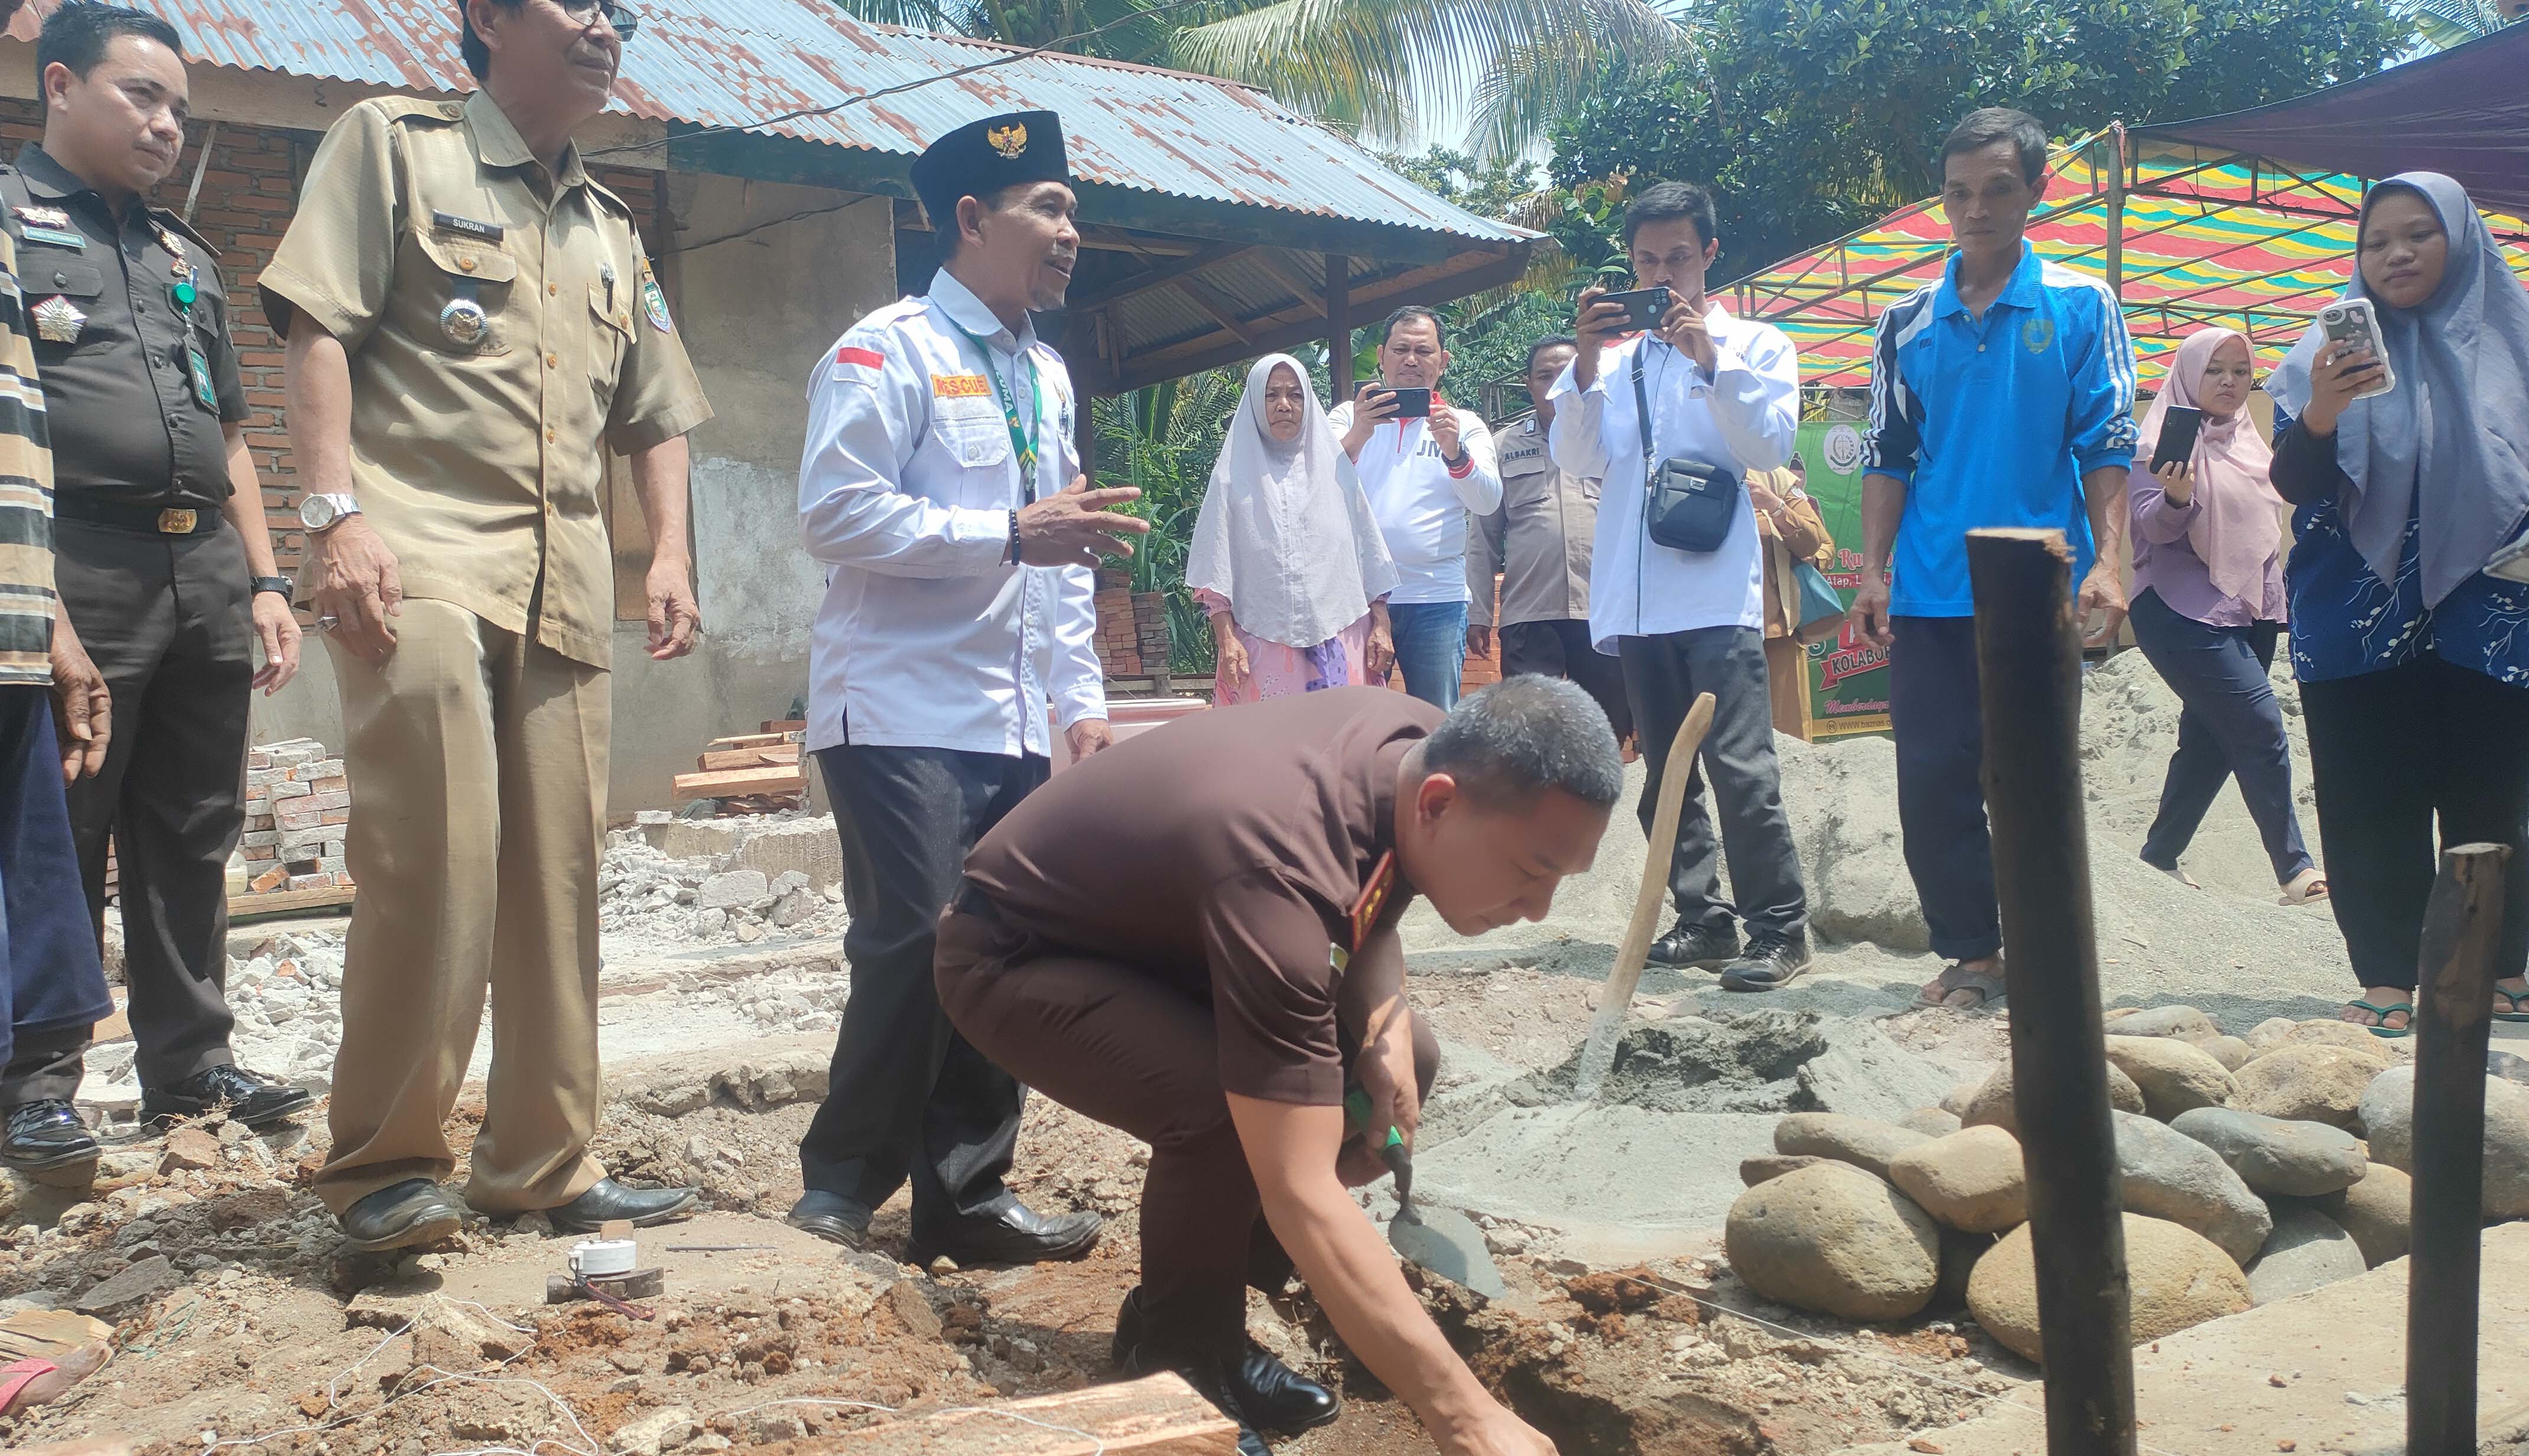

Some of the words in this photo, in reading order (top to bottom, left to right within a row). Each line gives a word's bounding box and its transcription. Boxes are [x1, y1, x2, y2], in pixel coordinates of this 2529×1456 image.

[453, 219, 485, 233] SUKRAN
[936, 378, 987, 395] RESCUE
[1416, 440, 1441, 457] JM
[1505, 447, 1539, 461] ALBAKRI
[1827, 576, 1852, 587] Atap,
[1831, 644, 1890, 675] KOLABOR
[1825, 698, 1890, 714] Memberdaya
[1839, 720, 1891, 730] WWW.baznas.g
